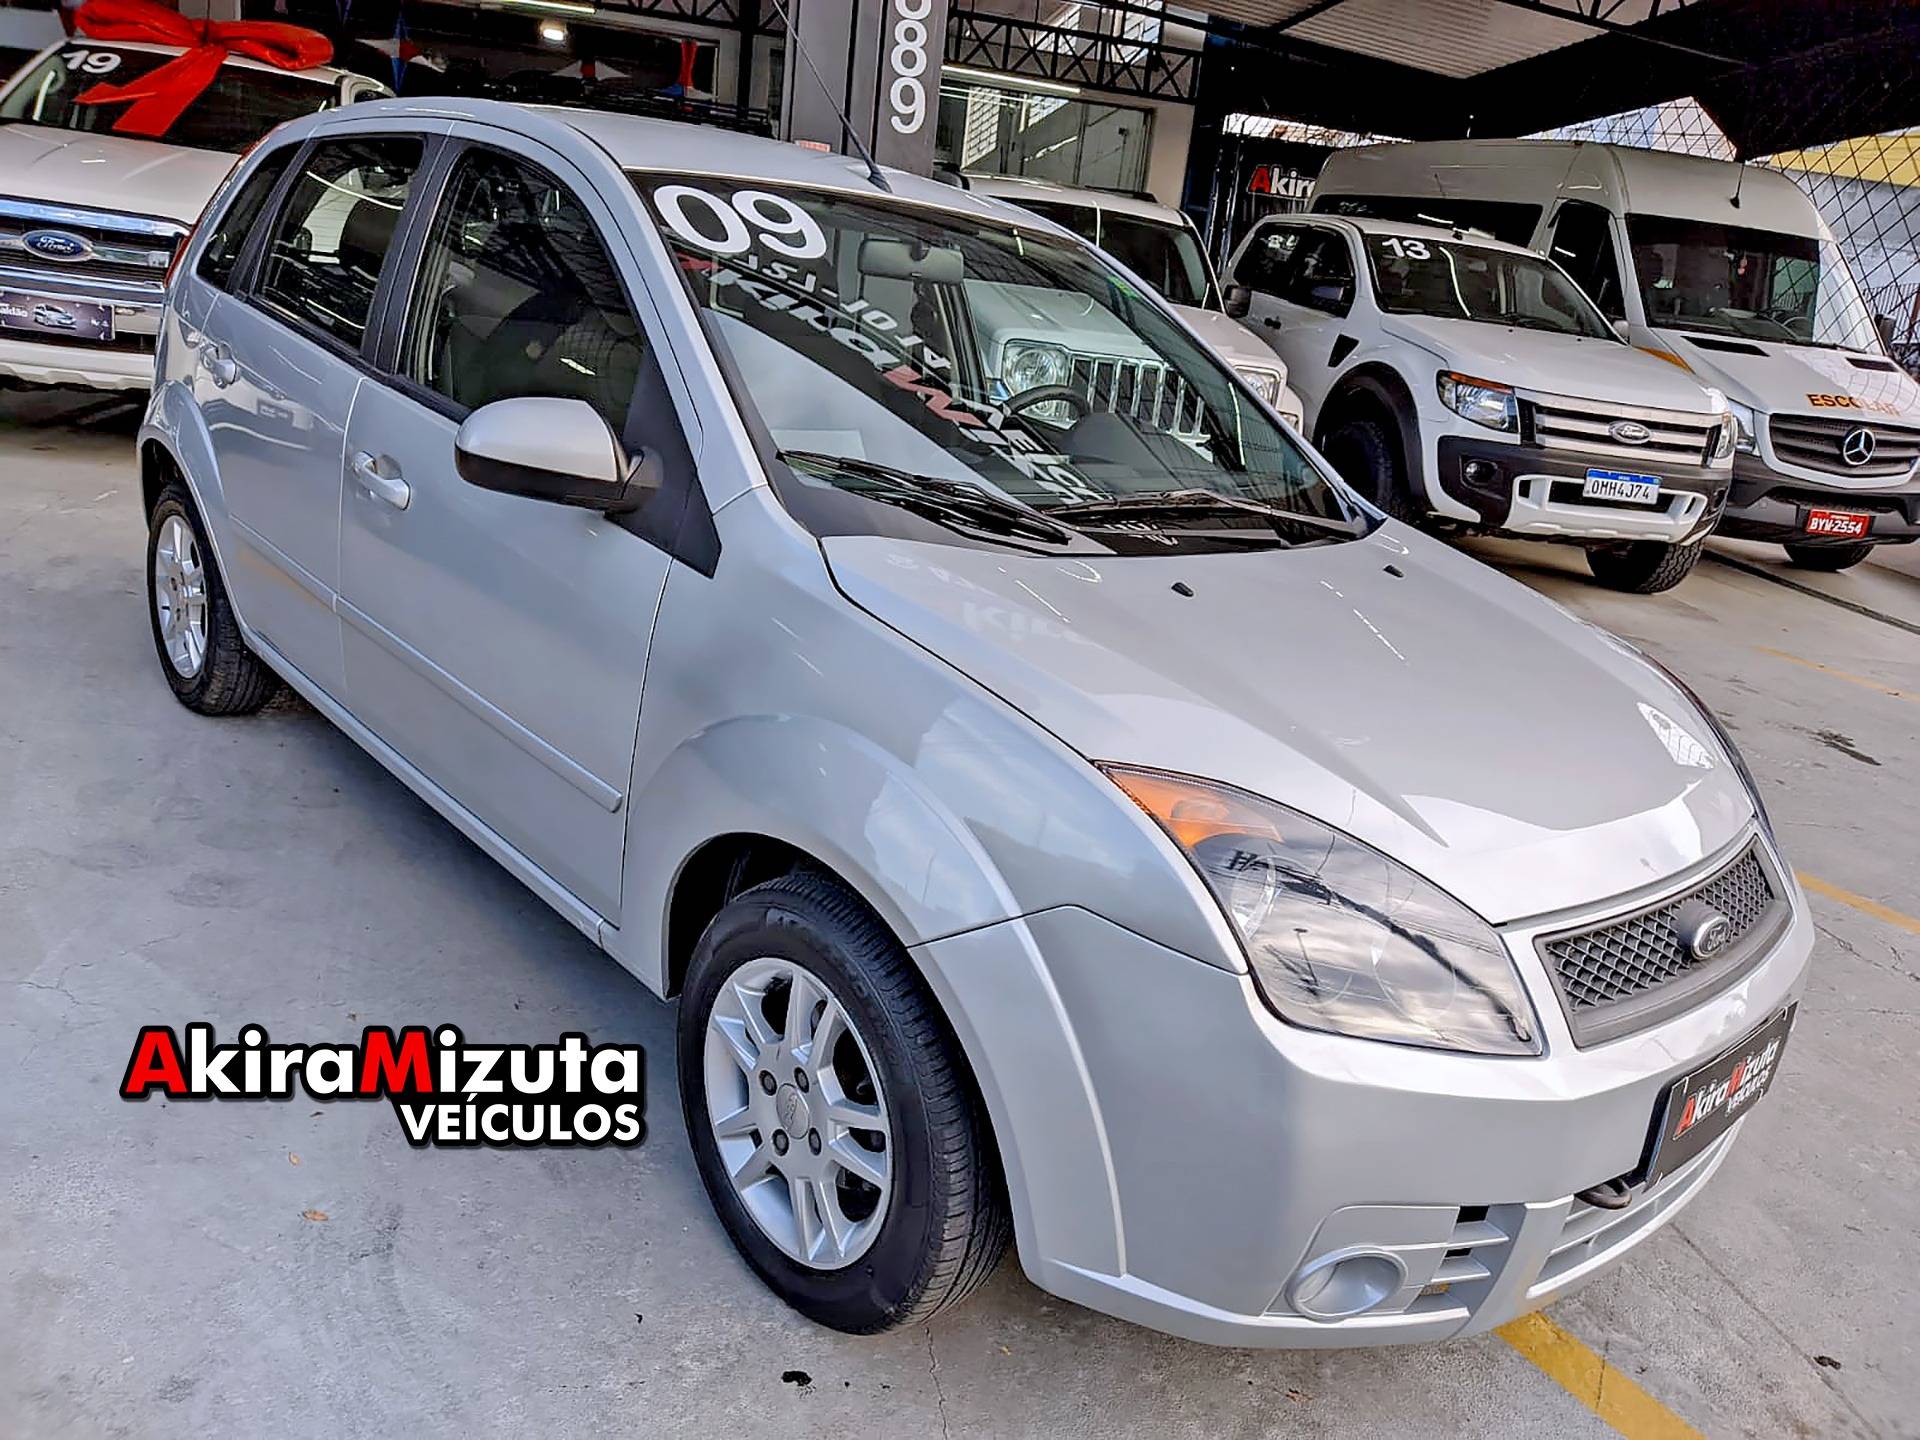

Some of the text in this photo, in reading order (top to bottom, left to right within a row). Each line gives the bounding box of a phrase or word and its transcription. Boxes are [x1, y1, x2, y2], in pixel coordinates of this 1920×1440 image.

[61, 49, 122, 74] 19
[654, 184, 827, 258] 09
[1382, 238, 1431, 260] 13
